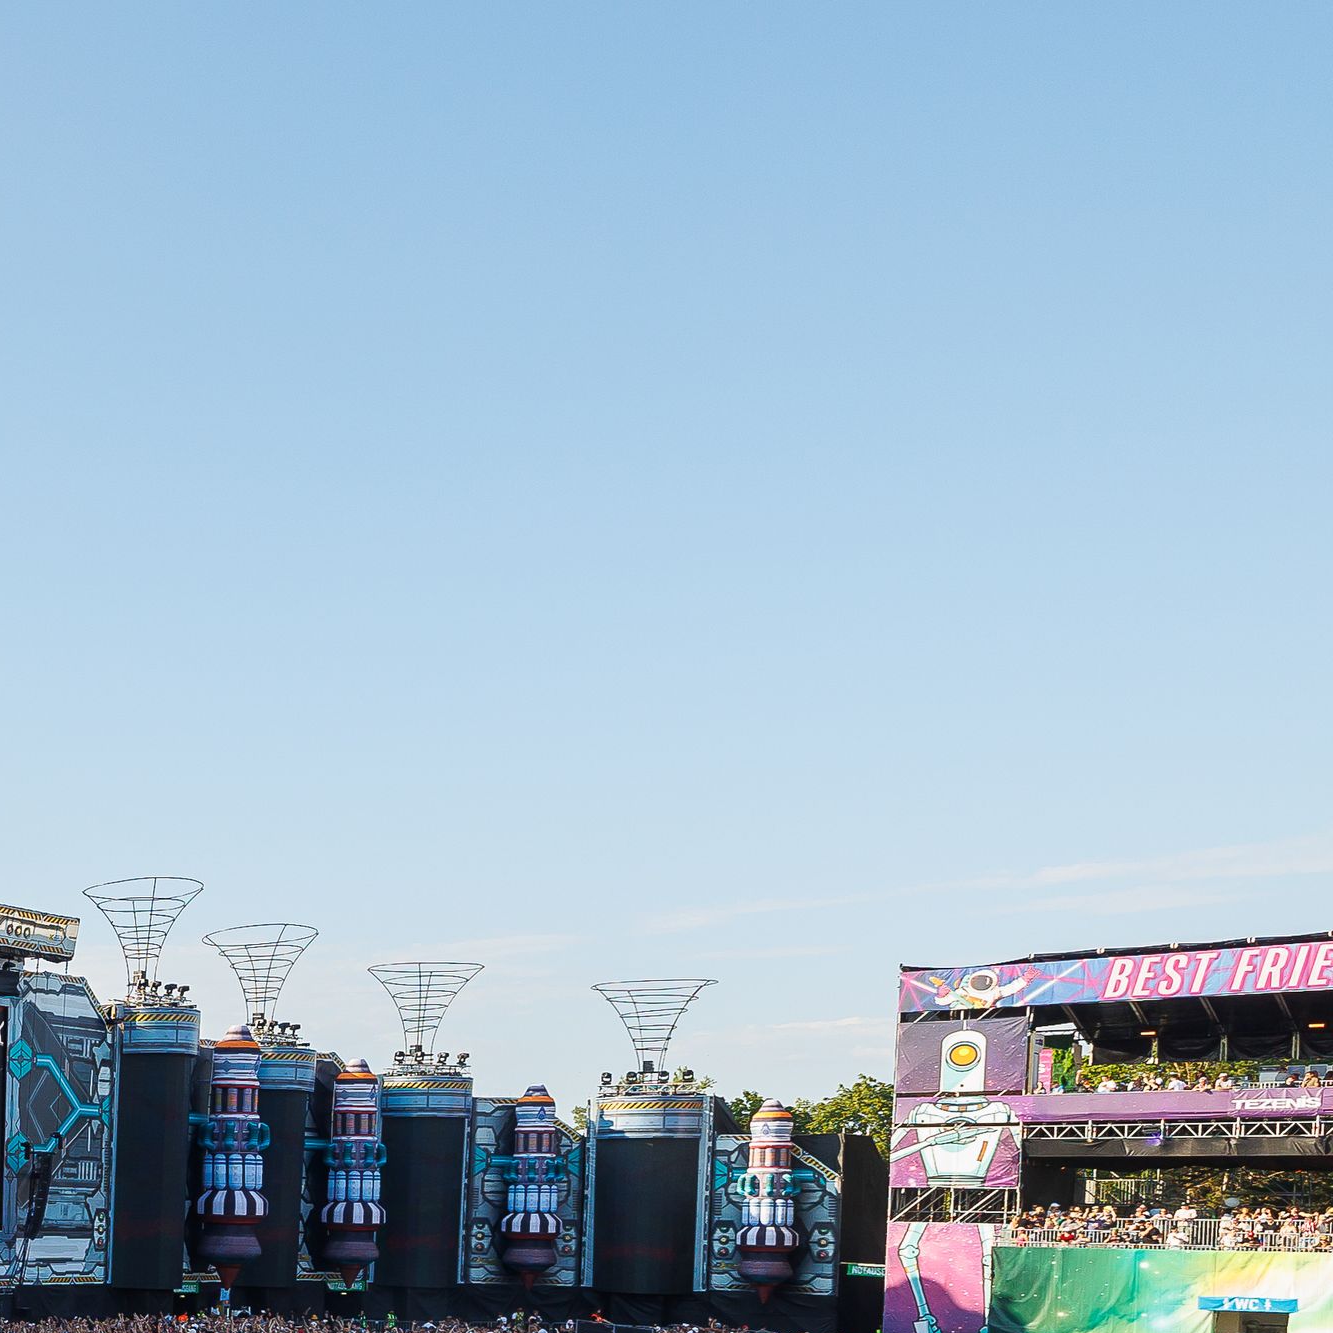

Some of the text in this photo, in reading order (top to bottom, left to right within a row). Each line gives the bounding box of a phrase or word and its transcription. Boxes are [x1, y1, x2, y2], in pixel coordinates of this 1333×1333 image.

[1103, 952, 1219, 999] BEST
[1231, 1096, 1321, 1110] TEZENIS
[1235, 1298, 1259, 1310] WC
